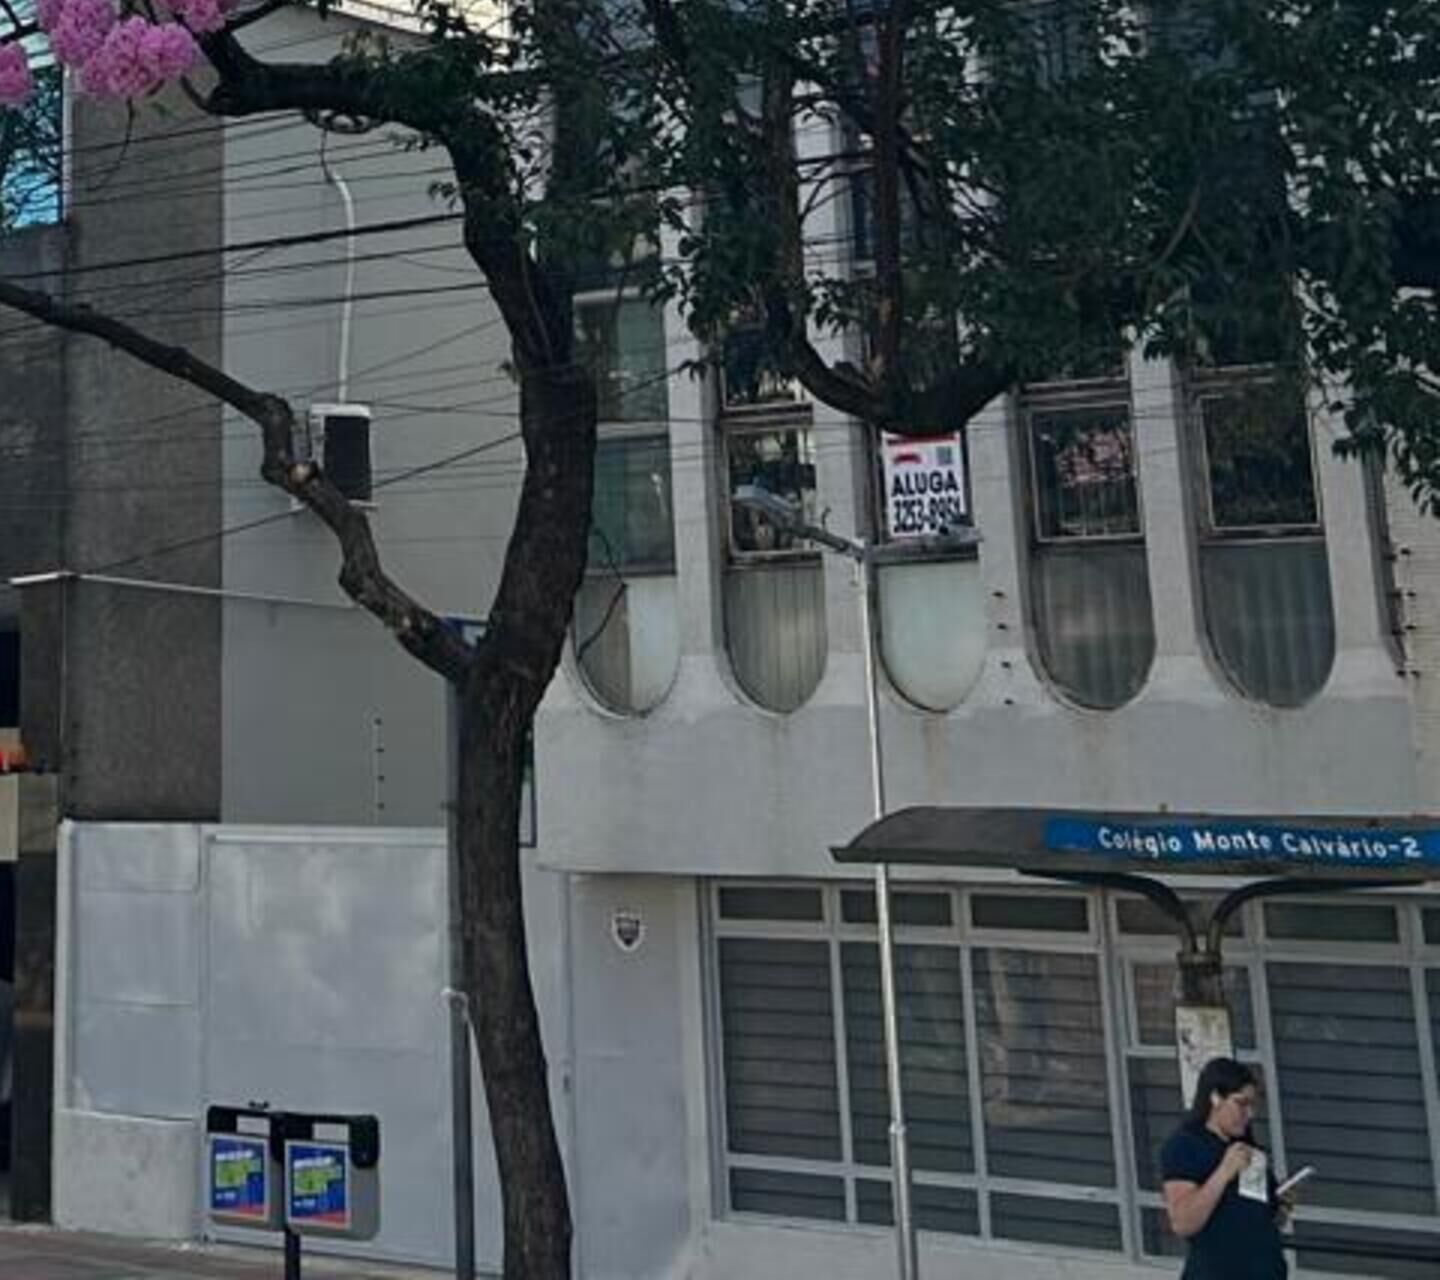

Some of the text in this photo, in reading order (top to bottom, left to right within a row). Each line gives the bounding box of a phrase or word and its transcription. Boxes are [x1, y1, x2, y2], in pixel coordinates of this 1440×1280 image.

[891, 470, 958, 497] ALUGA
[1097, 826, 1423, 859] Colégio Monte Calvário-2
